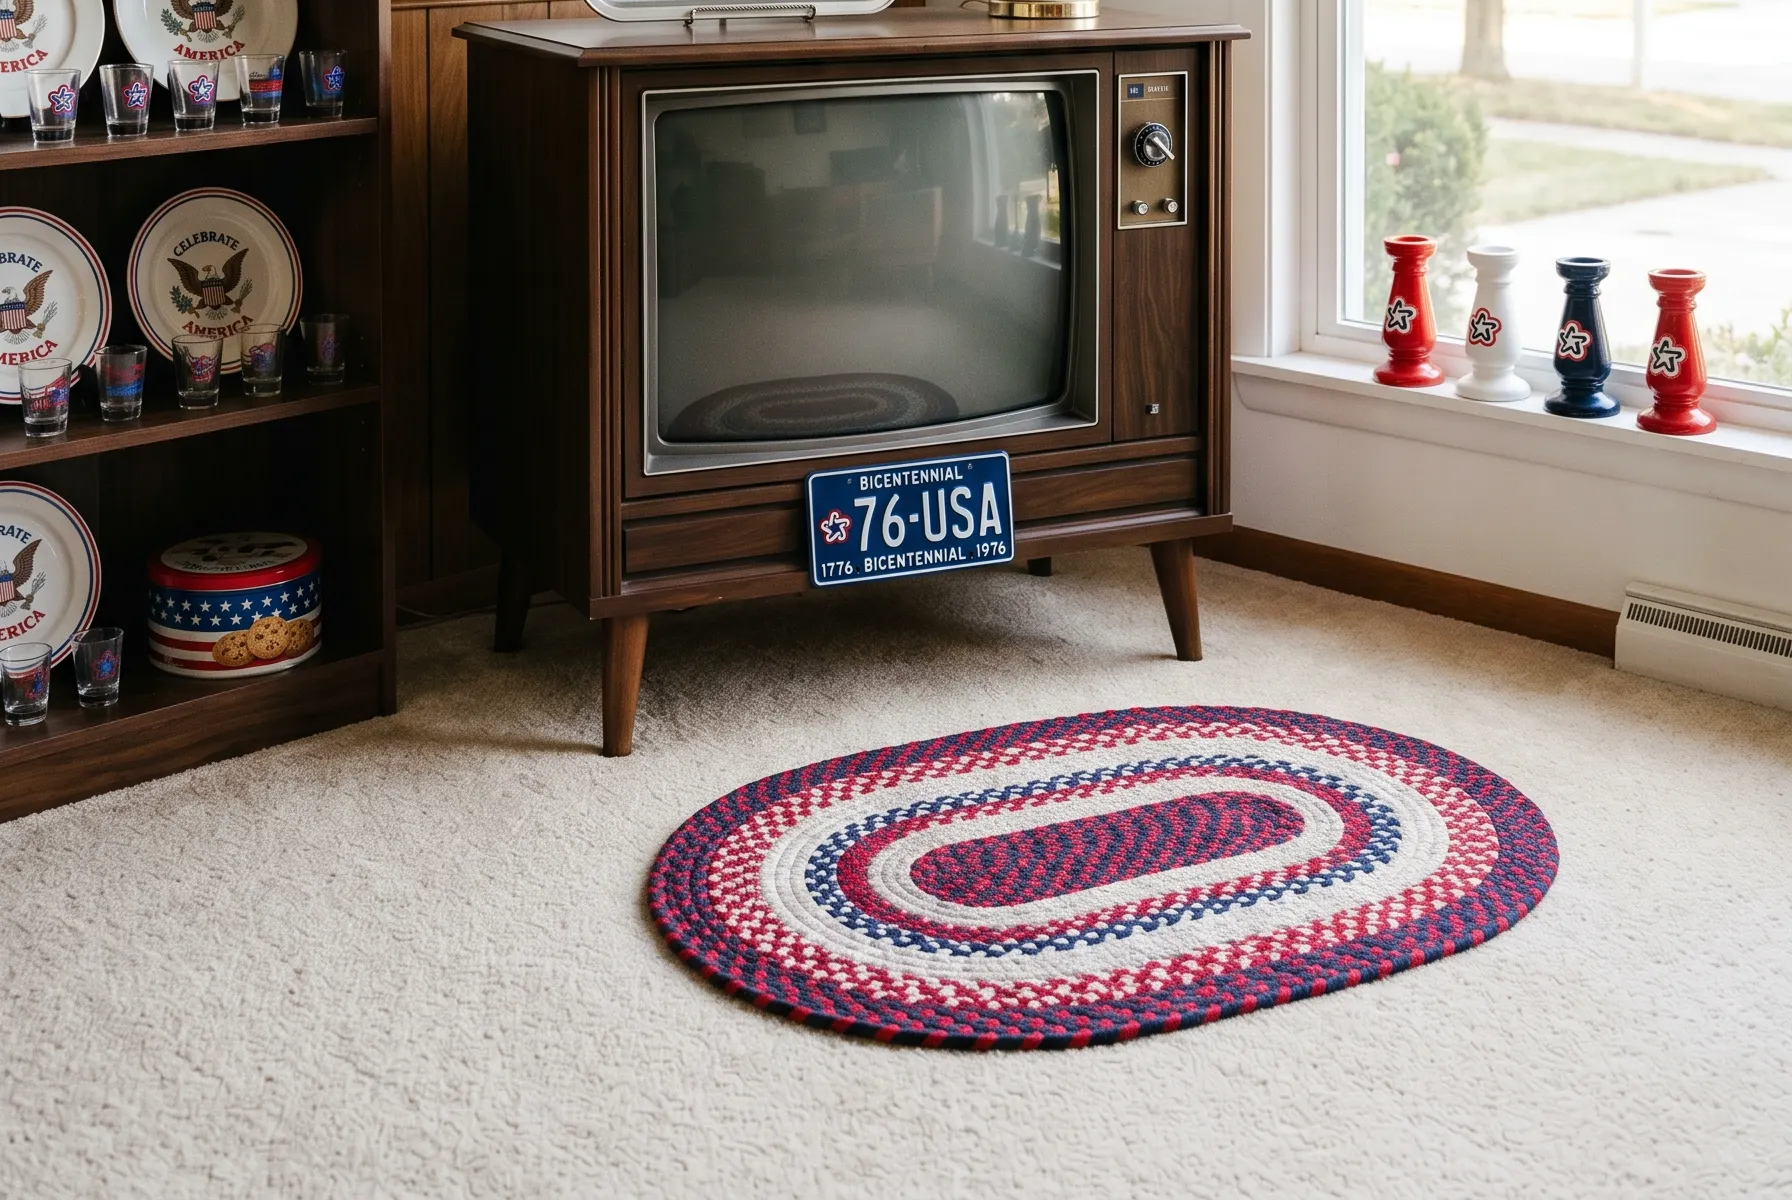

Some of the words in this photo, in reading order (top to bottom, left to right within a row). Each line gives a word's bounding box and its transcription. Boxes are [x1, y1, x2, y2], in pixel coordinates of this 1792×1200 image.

[172, 40, 246, 61] AMERICA
[172, 230, 241, 257] CELEBRATE
[181, 314, 255, 339] AMERICA
[859, 465, 963, 491] BICENTENNIAL
[853, 482, 1003, 552] 76-USA
[821, 560, 853, 578] 1776
[864, 546, 967, 573] BICENTENNIAL
[976, 541, 1007, 558] 1976
